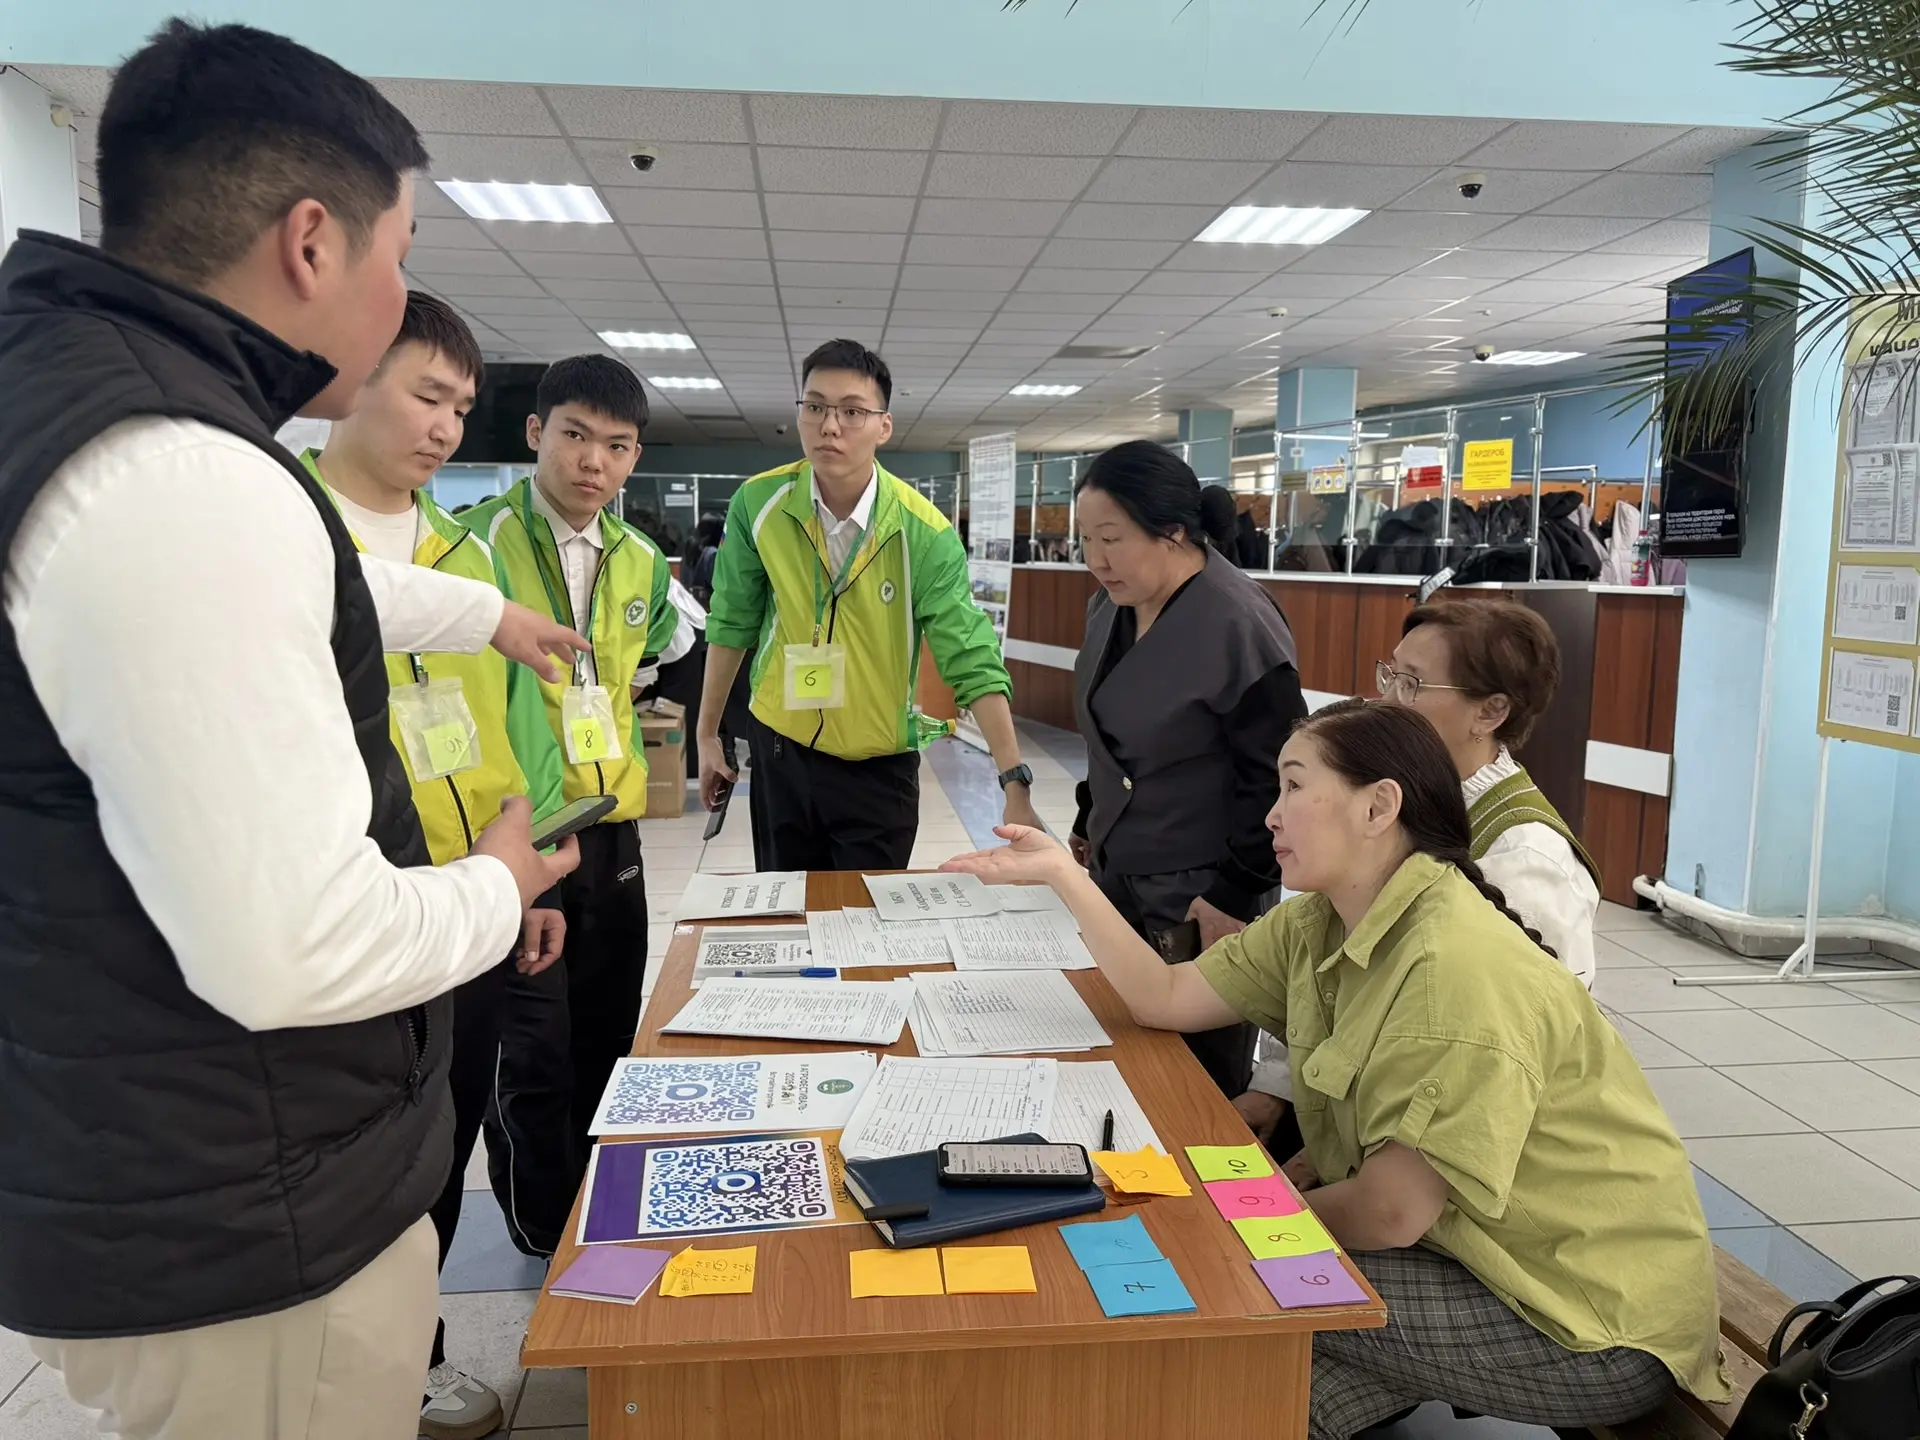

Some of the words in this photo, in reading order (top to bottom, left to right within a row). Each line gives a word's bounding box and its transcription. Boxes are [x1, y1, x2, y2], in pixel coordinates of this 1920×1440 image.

[1470, 448, 1505, 458] ГАРДЕРОБ
[804, 670, 817, 687] 6
[584, 729, 593, 749] 8
[1227, 1158, 1251, 1175] 10
[1267, 1232, 1302, 1243] 8
[1123, 1280, 1156, 1295] 7
